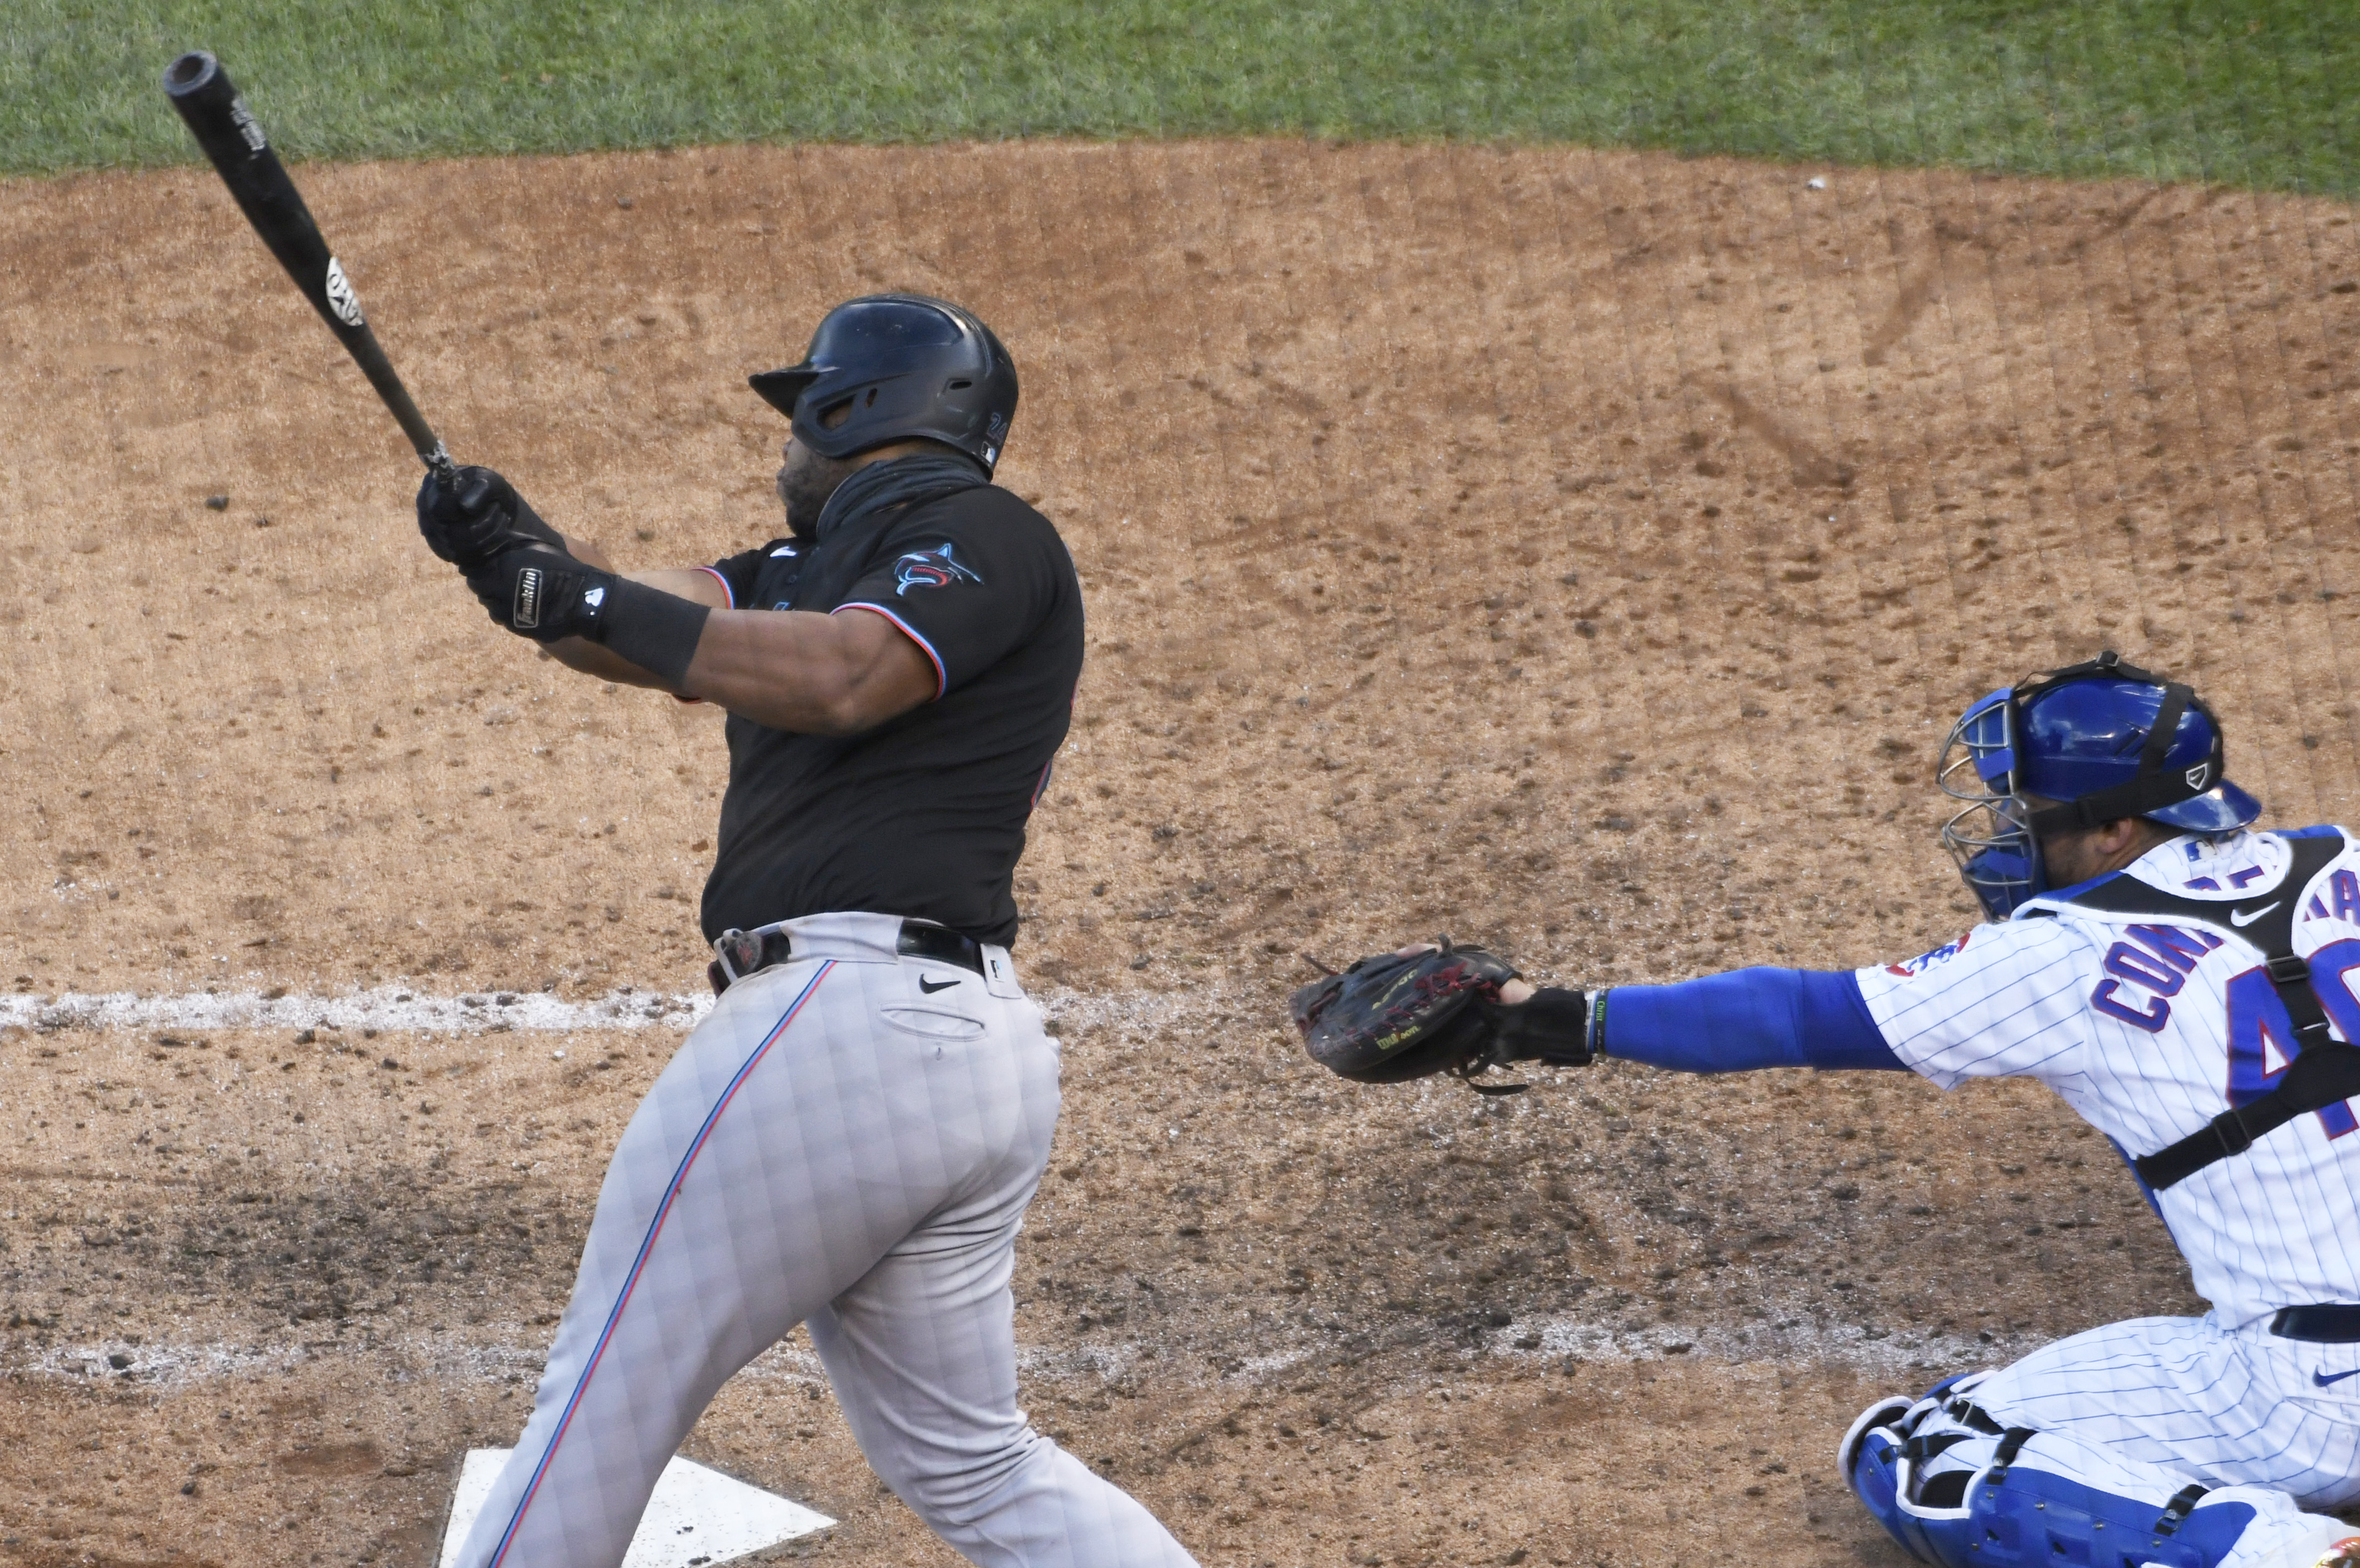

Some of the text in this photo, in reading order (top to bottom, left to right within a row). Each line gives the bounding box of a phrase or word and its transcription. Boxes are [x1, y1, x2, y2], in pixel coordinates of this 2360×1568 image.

[517, 572, 536, 625] Franklin
[1595, 1000, 1605, 1021] Christ
[1376, 1025, 1421, 1050] Wilson
